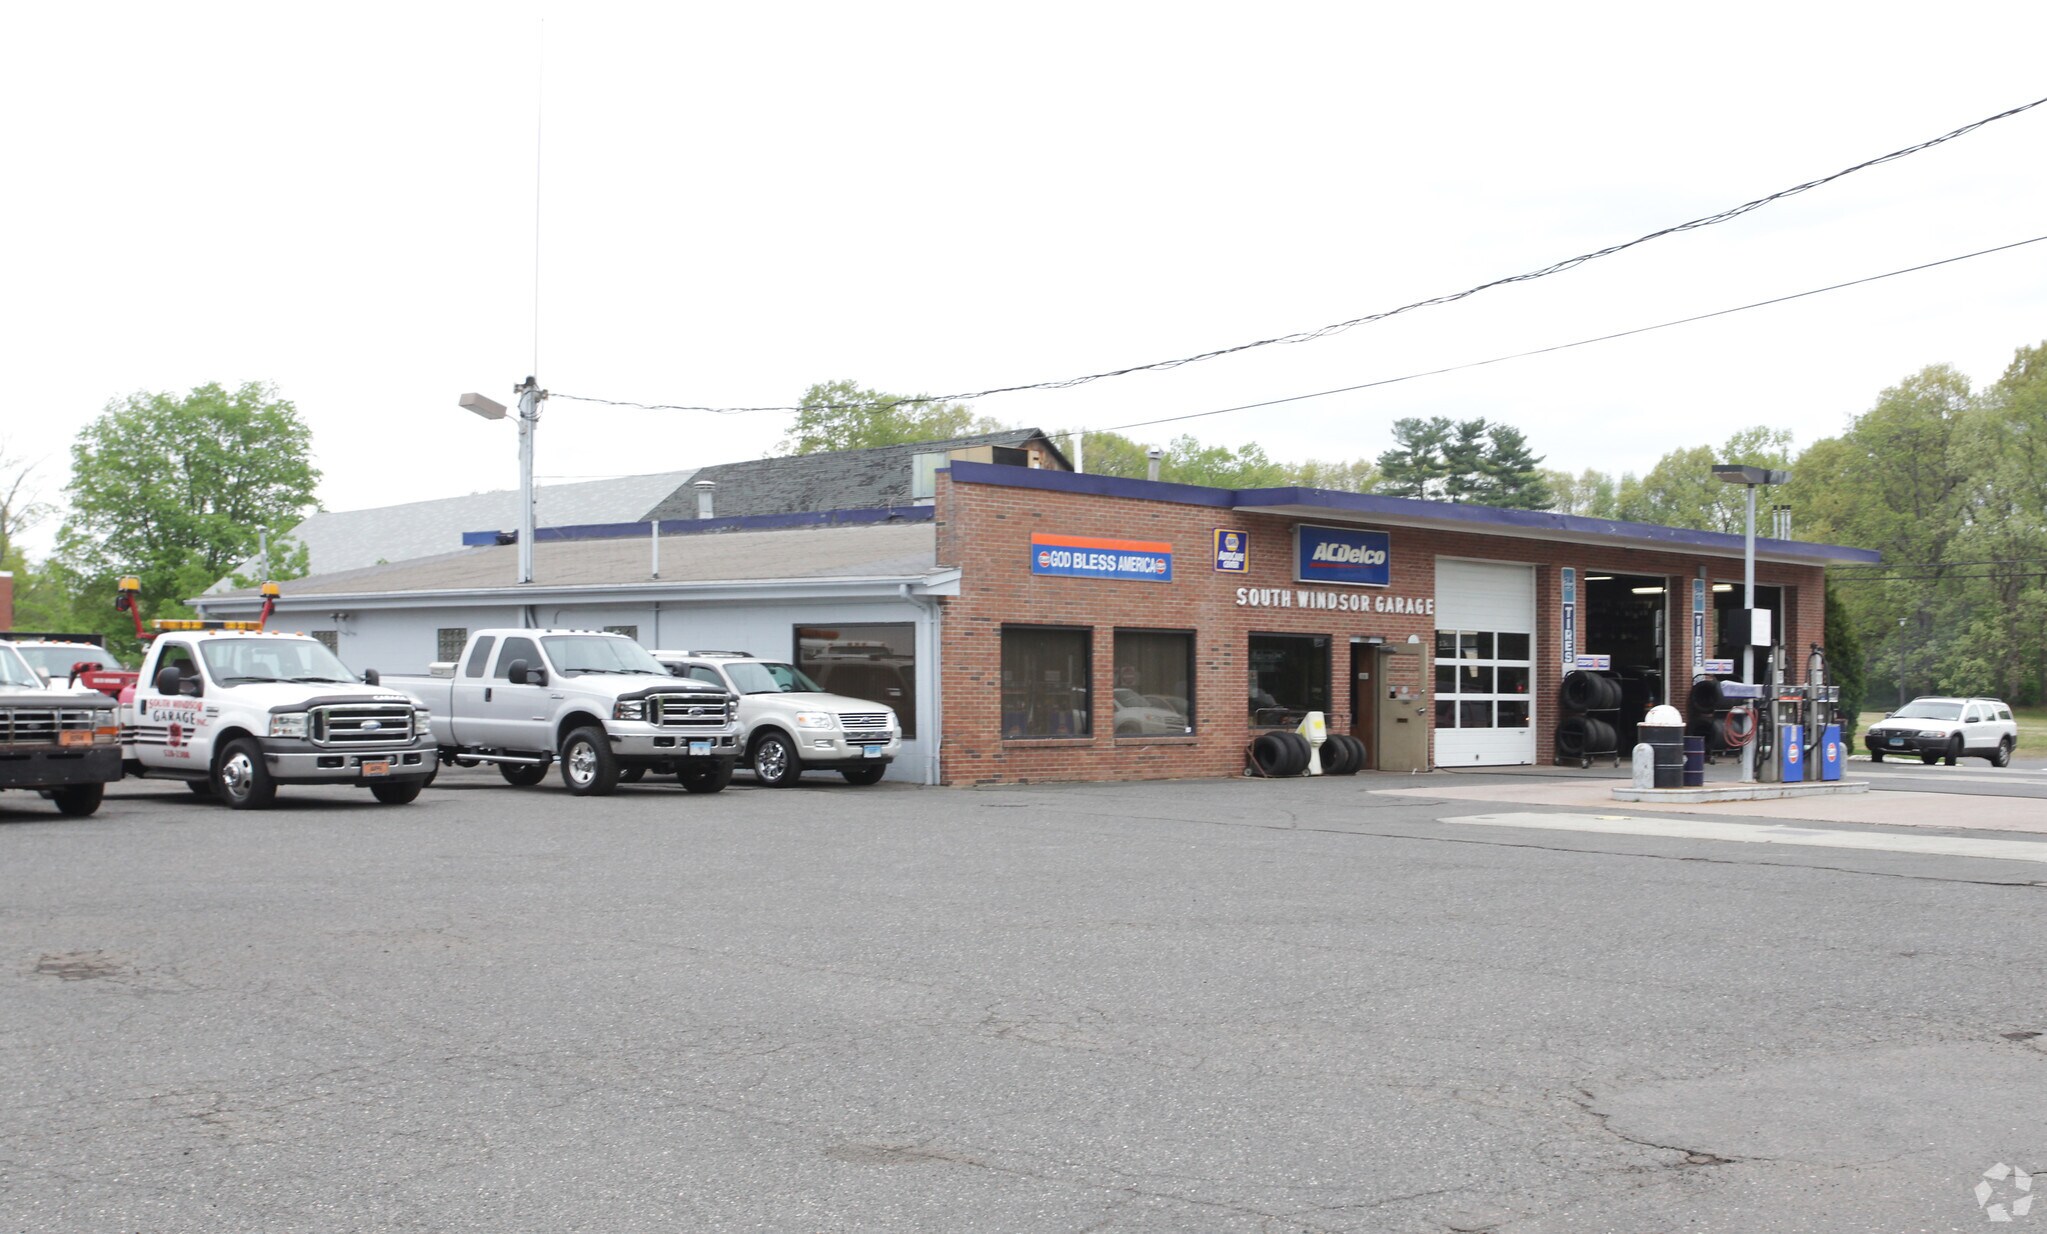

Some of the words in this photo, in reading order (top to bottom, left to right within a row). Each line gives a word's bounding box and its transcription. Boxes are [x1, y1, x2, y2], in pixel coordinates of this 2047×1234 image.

[1050, 550, 1071, 568] GOD
[1072, 552, 1116, 572] BLESS
[1117, 555, 1156, 573] AMERICA
[1312, 542, 1386, 565] ACDelco
[1236, 587, 1291, 608] SOUTH
[1297, 590, 1370, 612] WINDSOR
[1375, 596, 1434, 615] GARAGE
[1564, 606, 1573, 663] TIRES
[1695, 615, 1703, 667] TIRES
[153, 710, 196, 725] GARAGE
